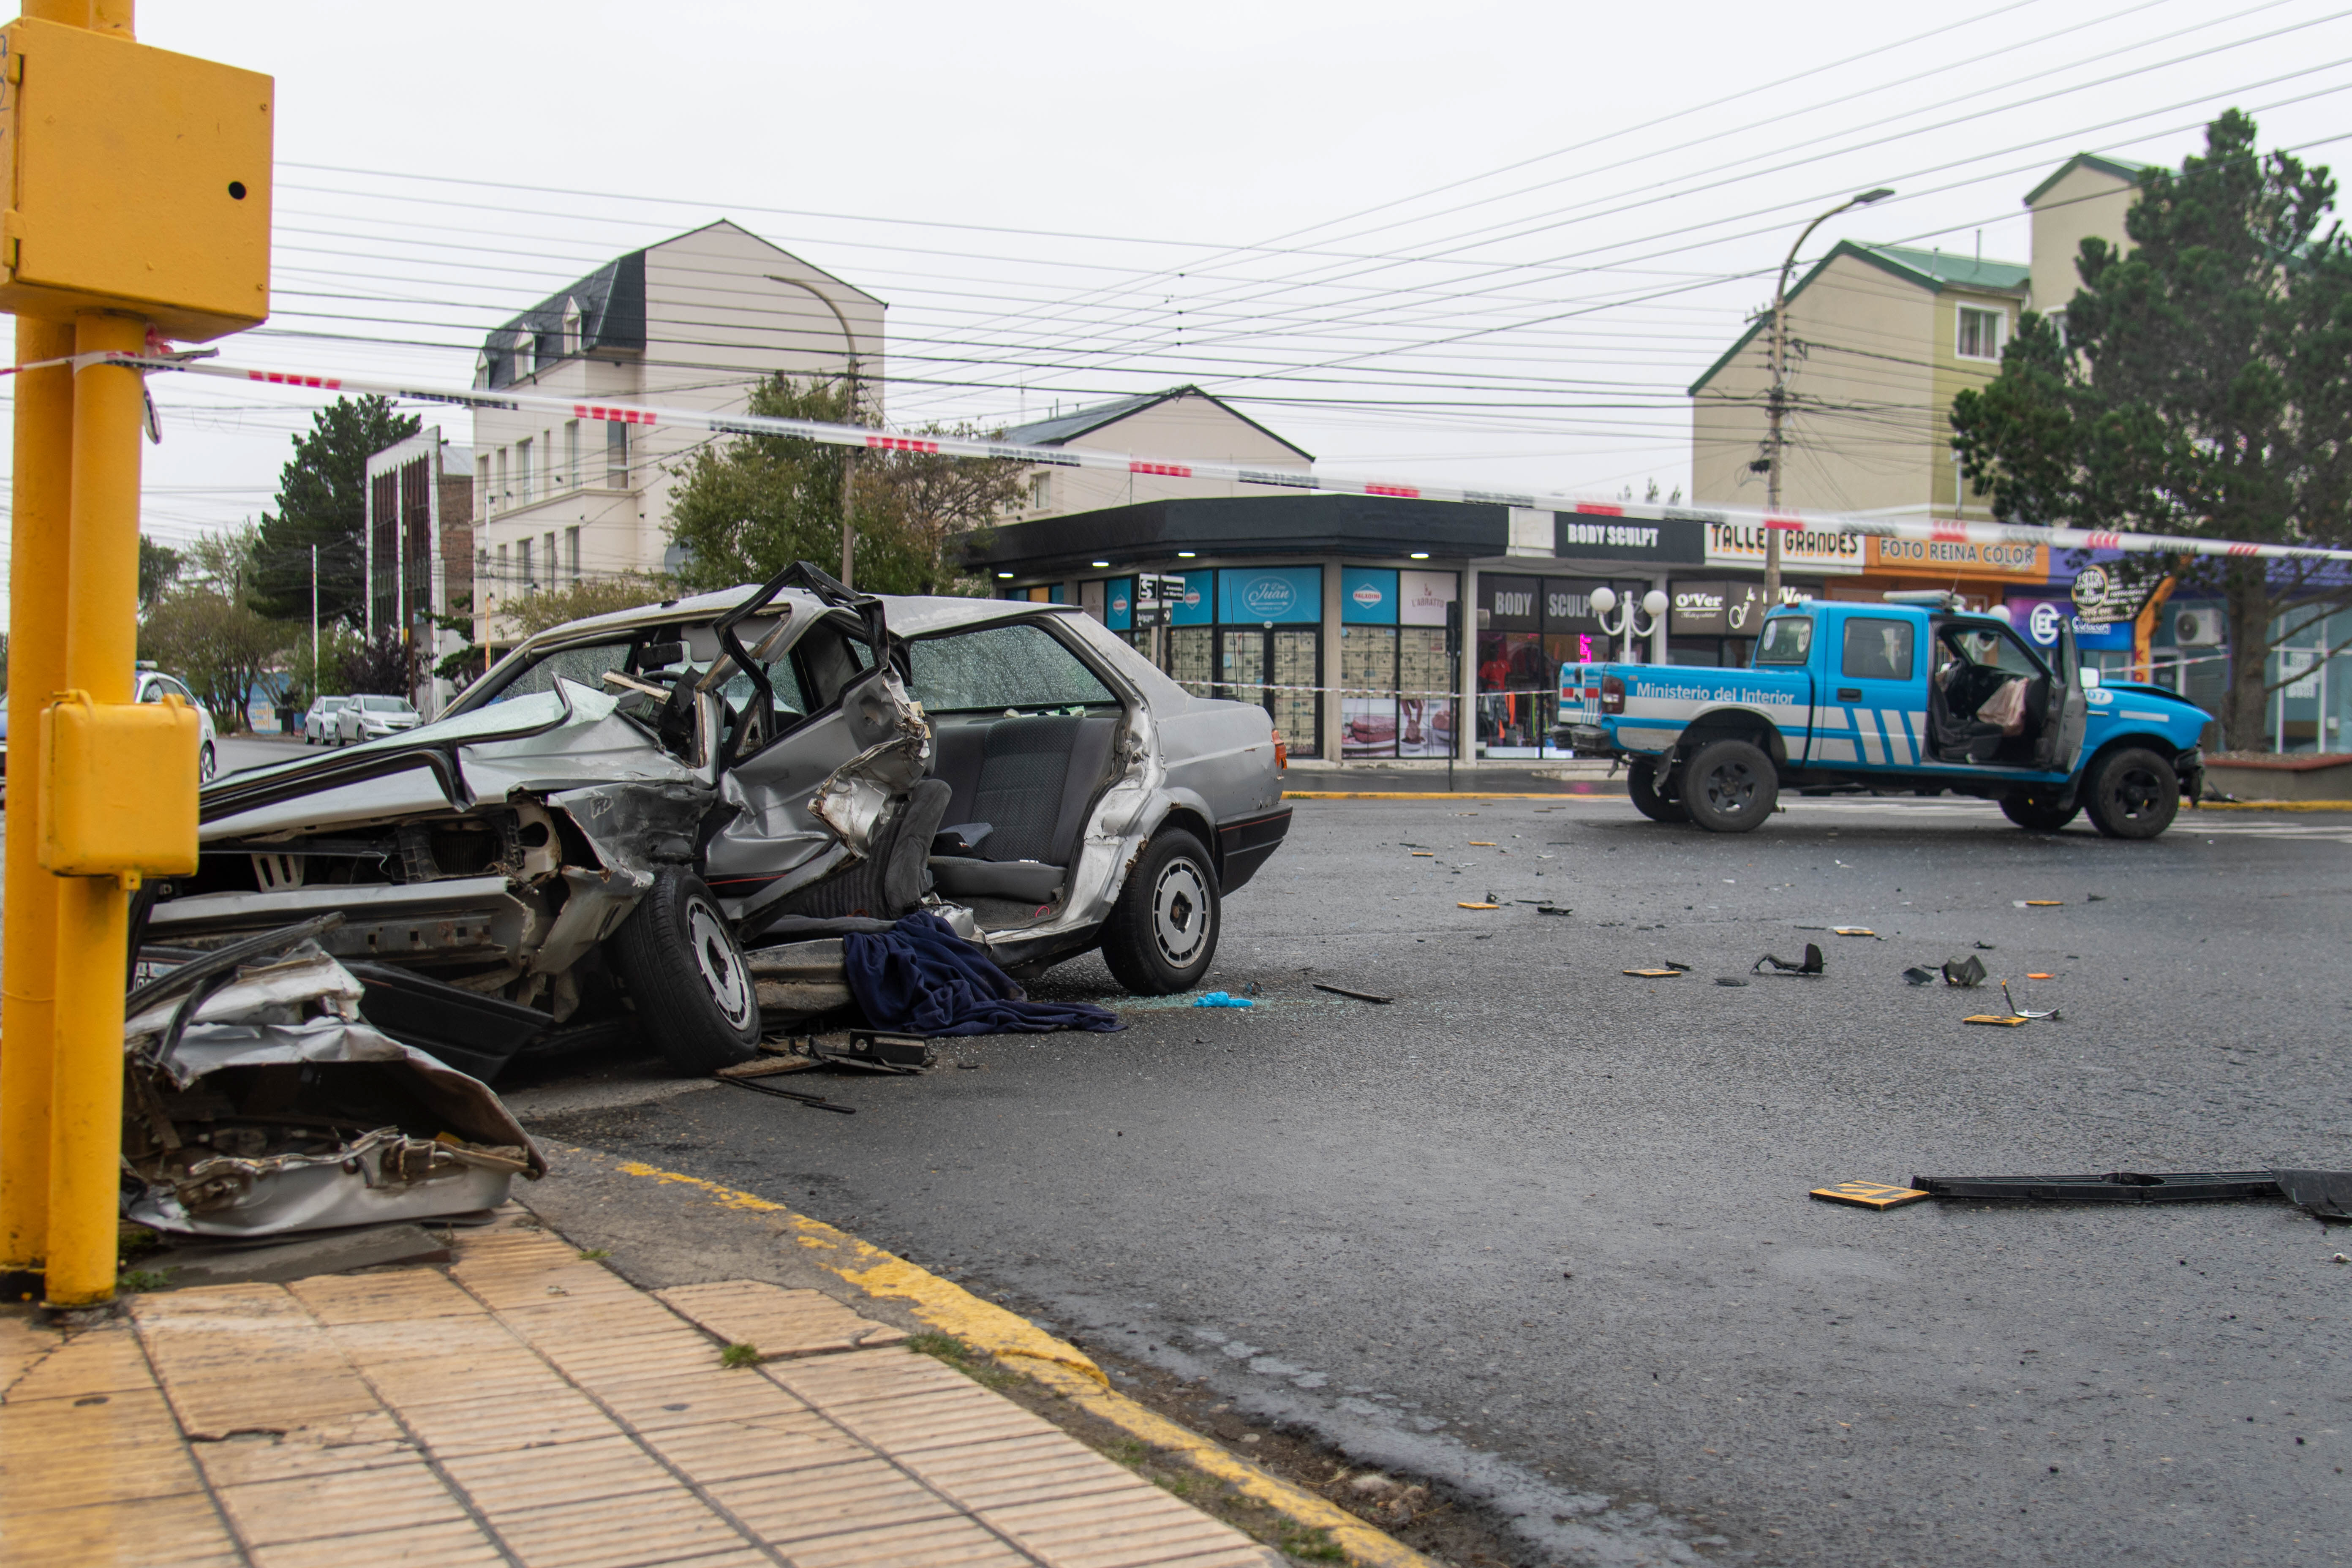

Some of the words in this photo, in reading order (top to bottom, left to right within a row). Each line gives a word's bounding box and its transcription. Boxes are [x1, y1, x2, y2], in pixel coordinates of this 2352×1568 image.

[1567, 523, 1606, 545] BODY
[1606, 525, 1659, 548] SCULPT
[1712, 524, 1766, 555] TALLE
[1784, 530, 1857, 558] GRANDES
[1880, 538, 1924, 560] FOTO
[1929, 542, 1978, 563] REINA
[1983, 545, 2036, 565] COLOR
[1248, 583, 1289, 602] Juan
[1494, 591, 1533, 616] BODY
[1675, 593, 1723, 607] O'Ver
[1580, 633, 1592, 664] LPT
[1636, 682, 1710, 701] Ministerio
[1714, 686, 1737, 702] del
[1741, 688, 1795, 705] Interior
